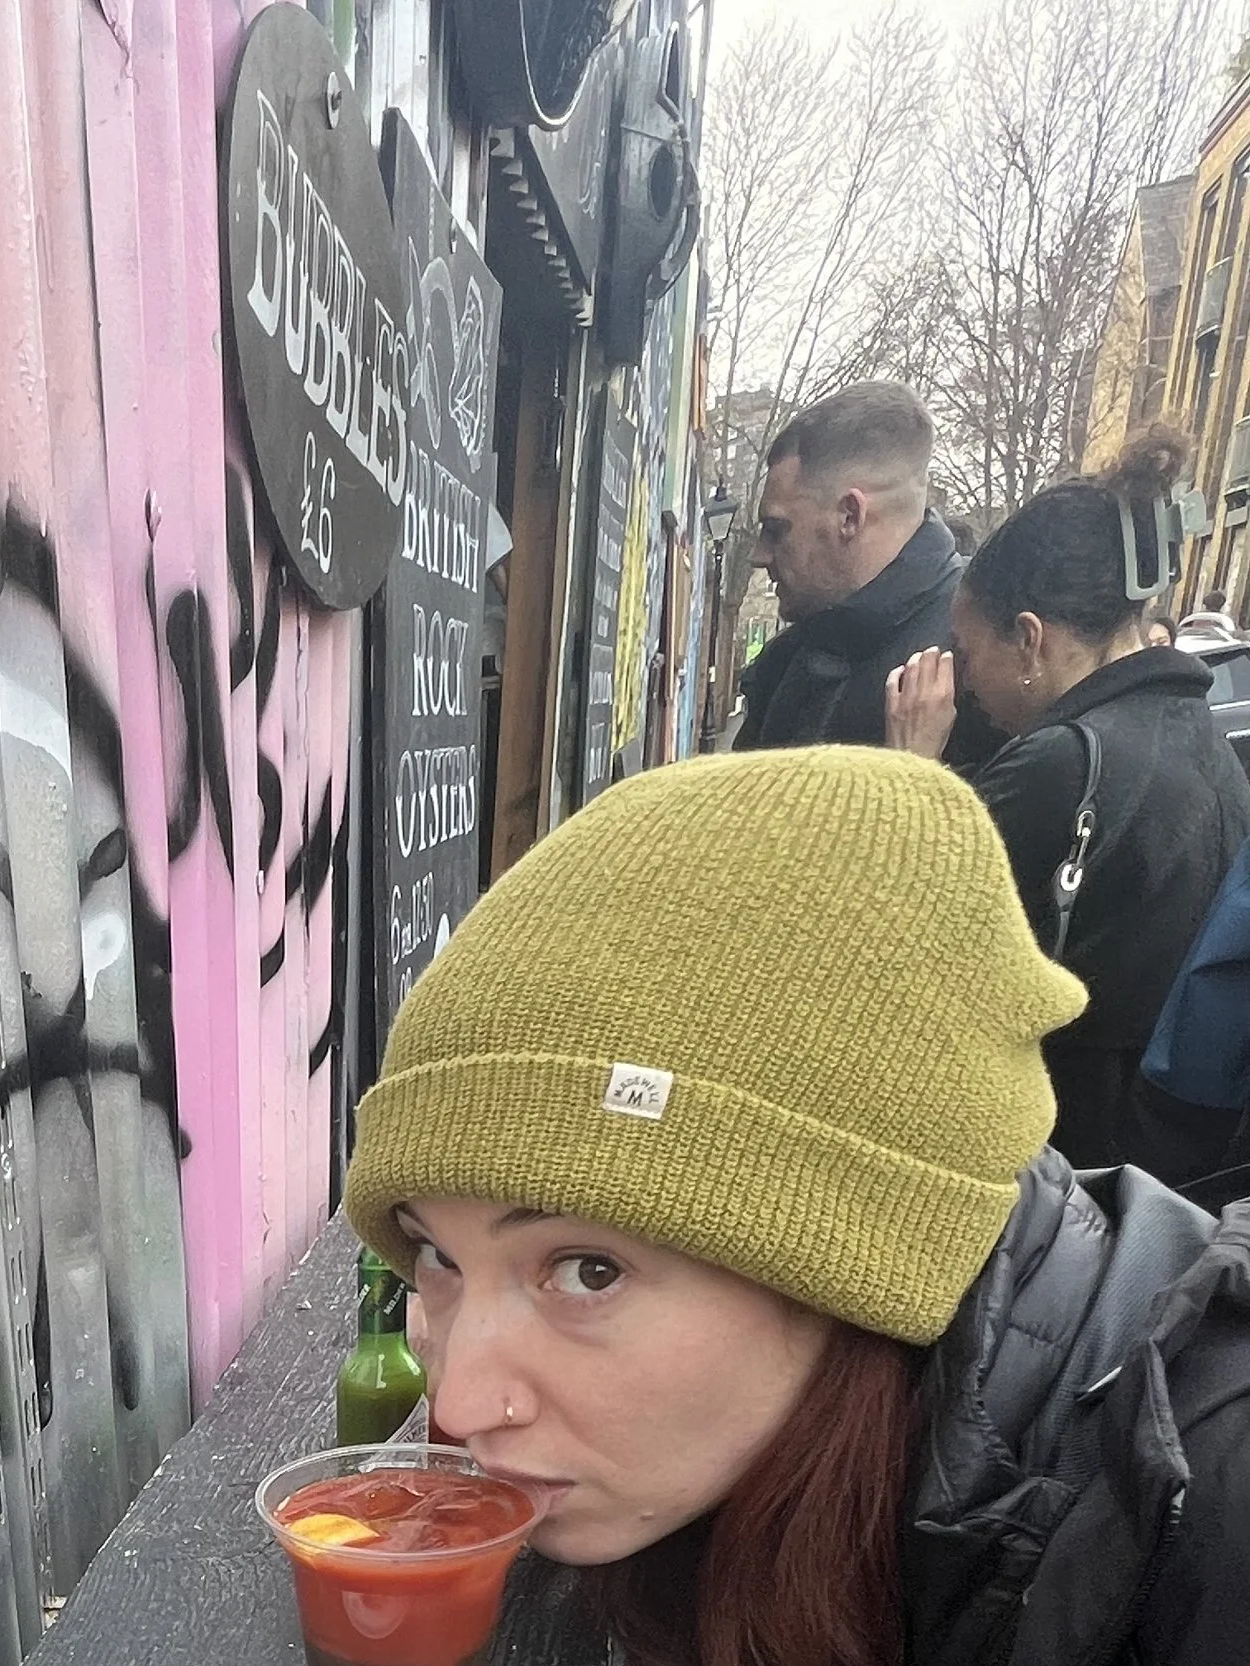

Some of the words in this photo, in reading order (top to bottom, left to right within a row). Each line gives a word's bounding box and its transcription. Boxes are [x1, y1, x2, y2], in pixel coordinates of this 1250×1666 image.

[247, 90, 410, 507] BUBBLES
[300, 431, 336, 575] £6
[401, 439, 482, 594] BRITISH
[411, 604, 470, 717] ROCK
[395, 743, 478, 859] OYSTERS
[626, 1089, 644, 1107] M
